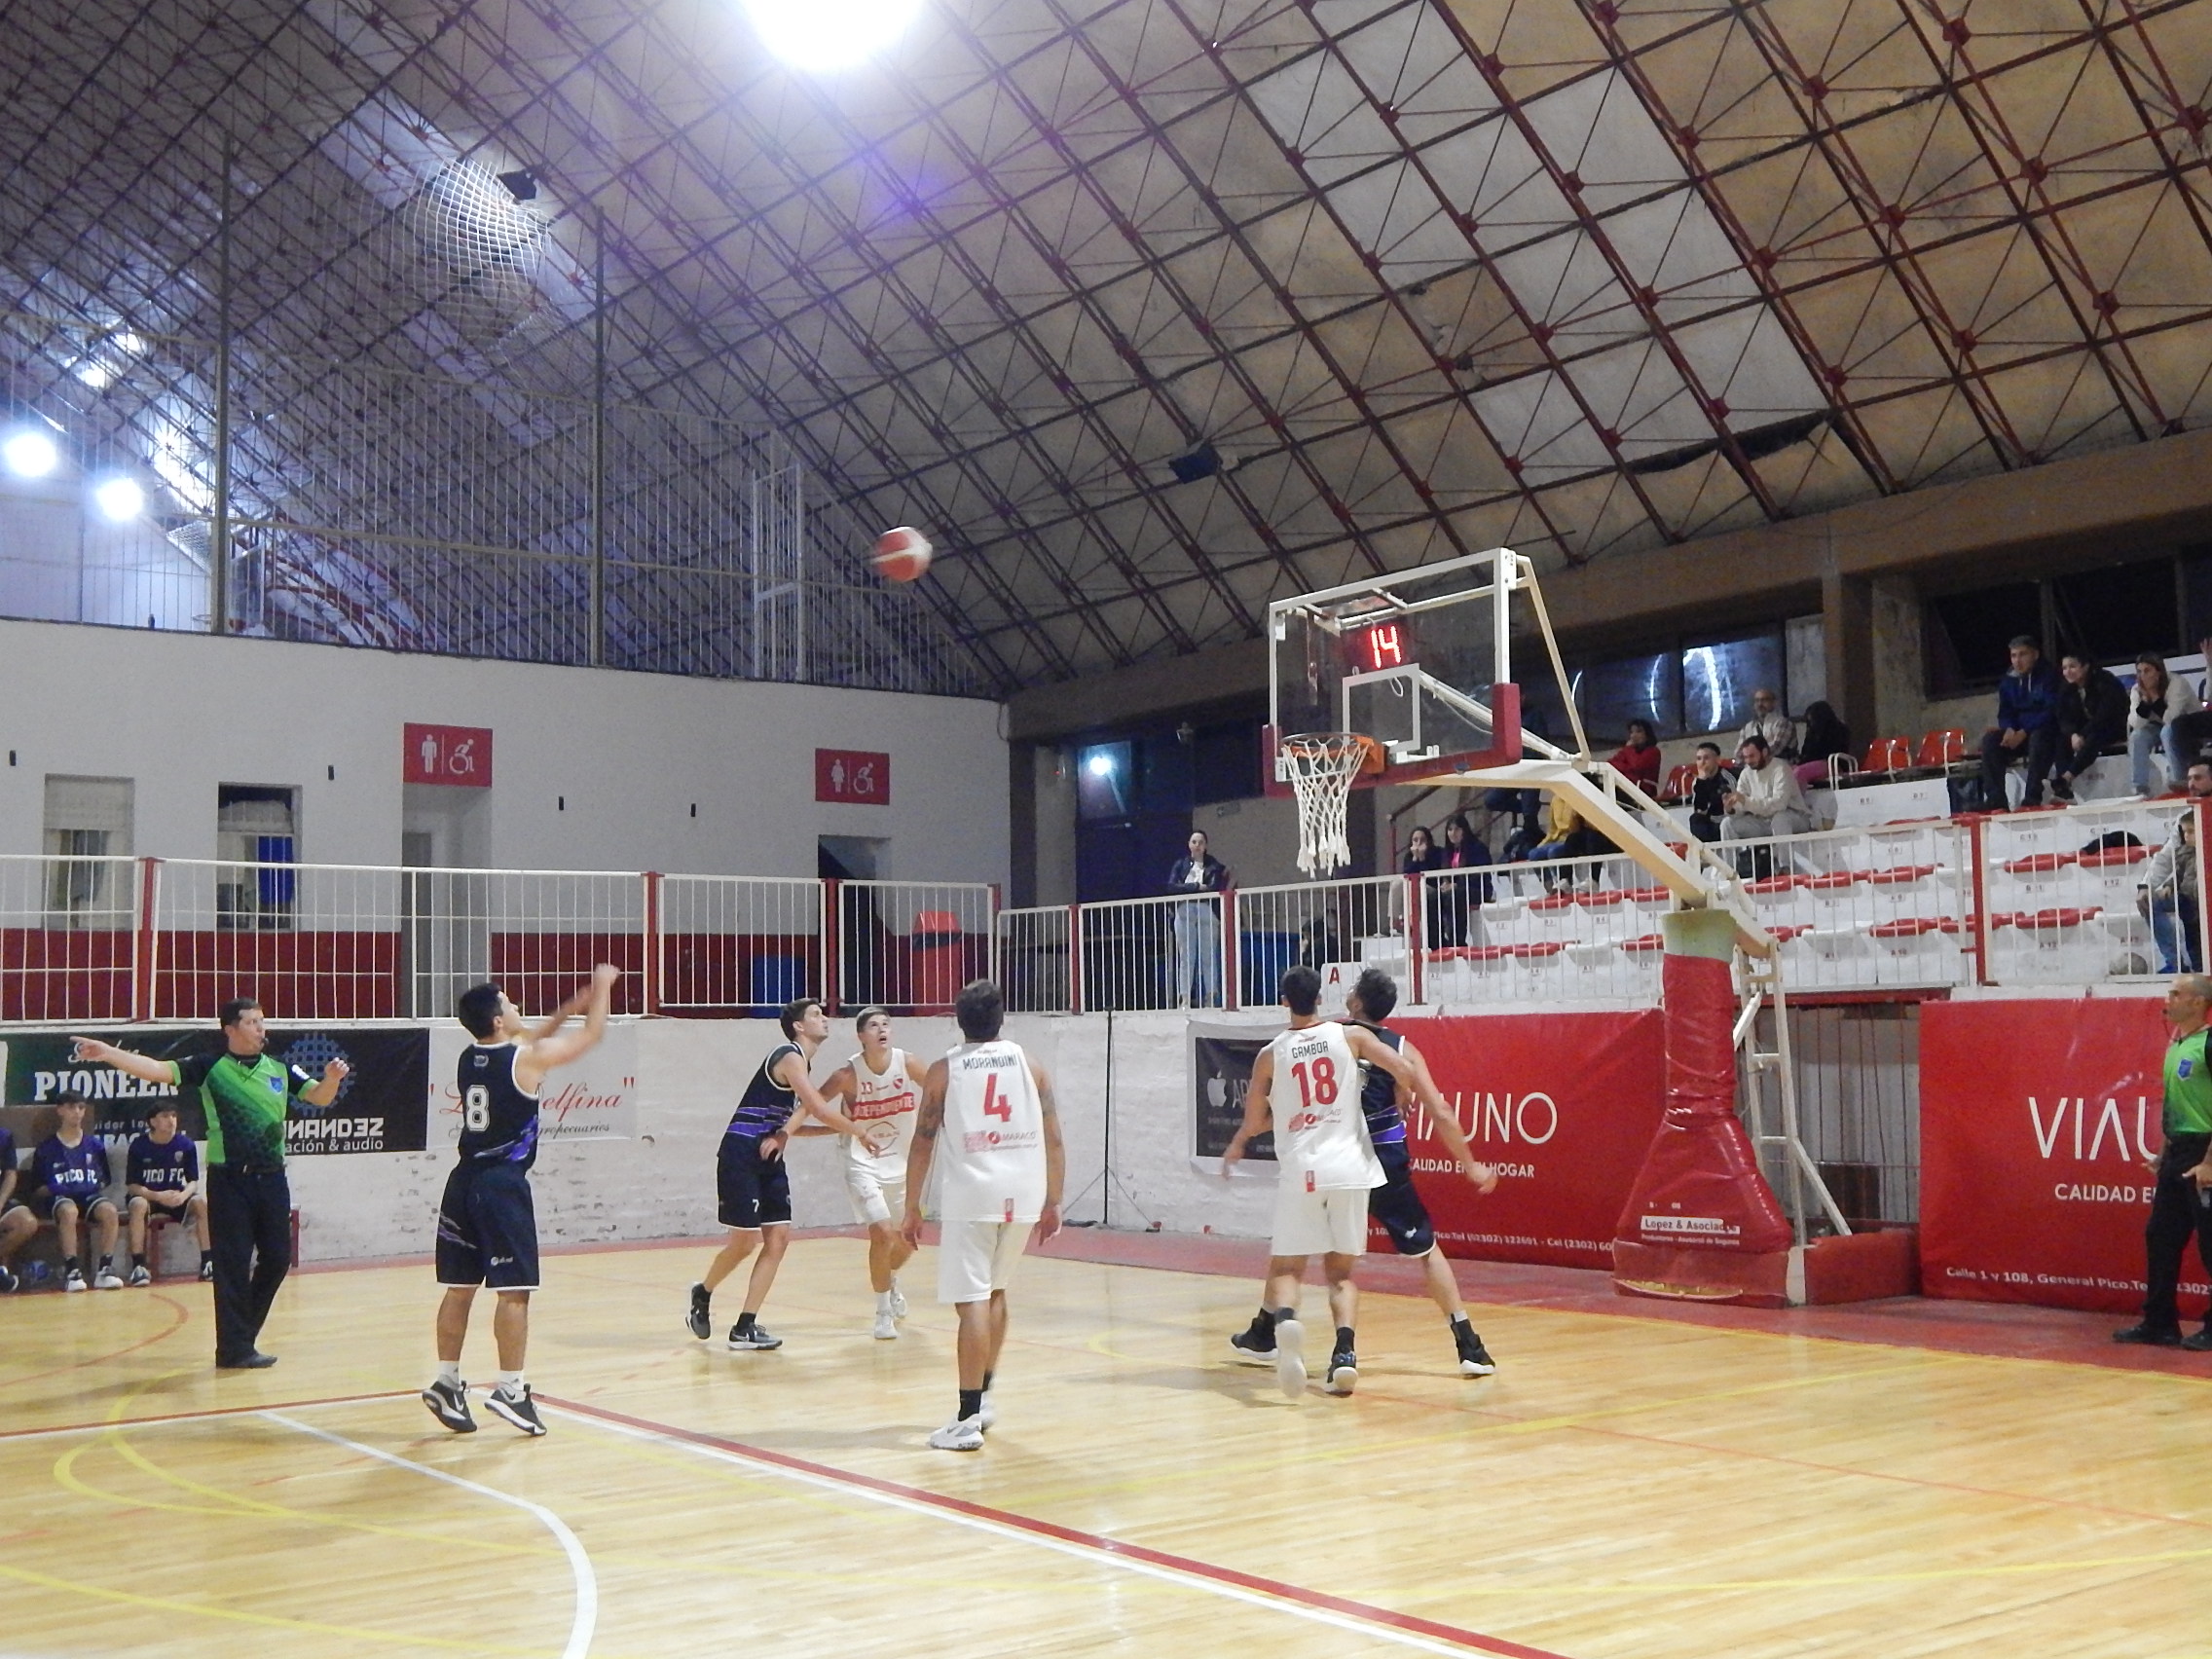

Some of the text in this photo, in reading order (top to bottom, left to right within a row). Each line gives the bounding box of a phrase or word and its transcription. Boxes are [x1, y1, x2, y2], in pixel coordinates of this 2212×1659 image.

[1371, 626, 1401, 668] 14
[1329, 967, 1340, 984] A
[1292, 1041, 1329, 1059] GAMBOA
[963, 1053, 1018, 1070] MORANDINI
[1291, 1056, 1339, 1108] 18
[984, 1073, 1012, 1122] 4
[466, 1085, 490, 1131] 8
[284, 1118, 384, 1139] NANDEZ
[343, 1136, 384, 1151] audio
[55, 1168, 85, 1183] PICO
[169, 1167, 185, 1182] FC
[1490, 1161, 1535, 1178] HOGAR
[2054, 1183, 2156, 1203] CALIDAD E
[752, 1198, 759, 1213] 7
[1645, 1219, 1673, 1231] Lopez
[1677, 1220, 1682, 1229] &
[1565, 1238, 1597, 1250] (2302)
[1947, 1267, 1976, 1279] Calle
[2037, 1273, 2094, 1287] General
[2098, 1277, 2148, 1292] Pico.Te
